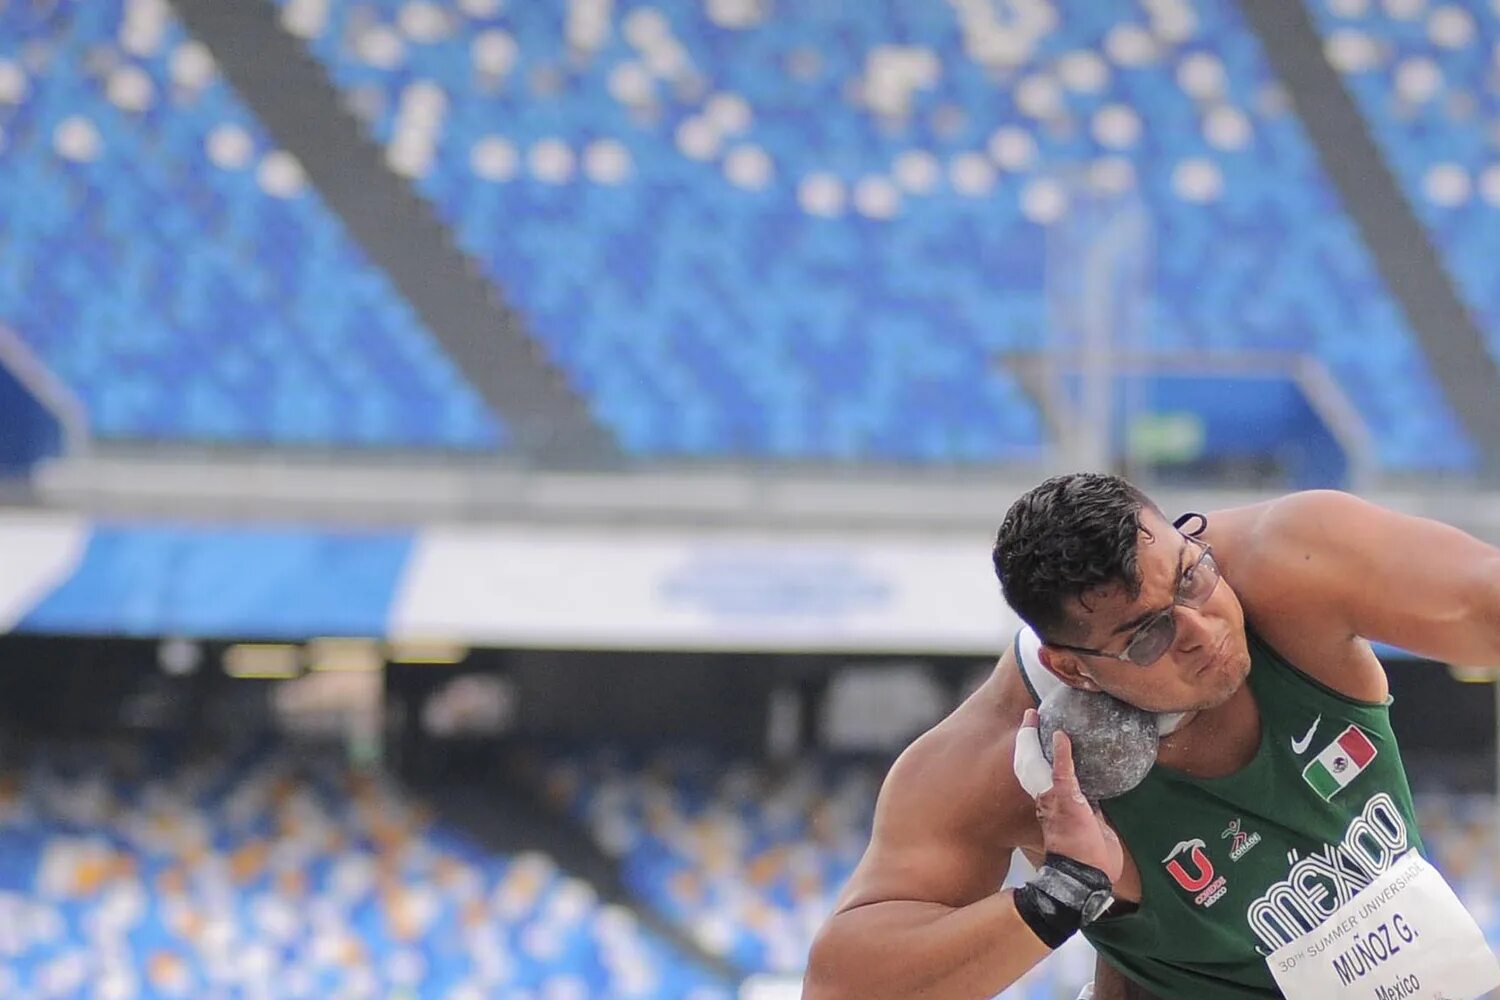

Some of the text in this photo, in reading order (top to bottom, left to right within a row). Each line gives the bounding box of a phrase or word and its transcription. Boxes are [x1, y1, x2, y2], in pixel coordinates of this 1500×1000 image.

[1306, 916, 1358, 958] SUMMER
[1358, 862, 1425, 920] UNIVERSIADE
[1332, 913, 1419, 987] MUÑOZ G.
